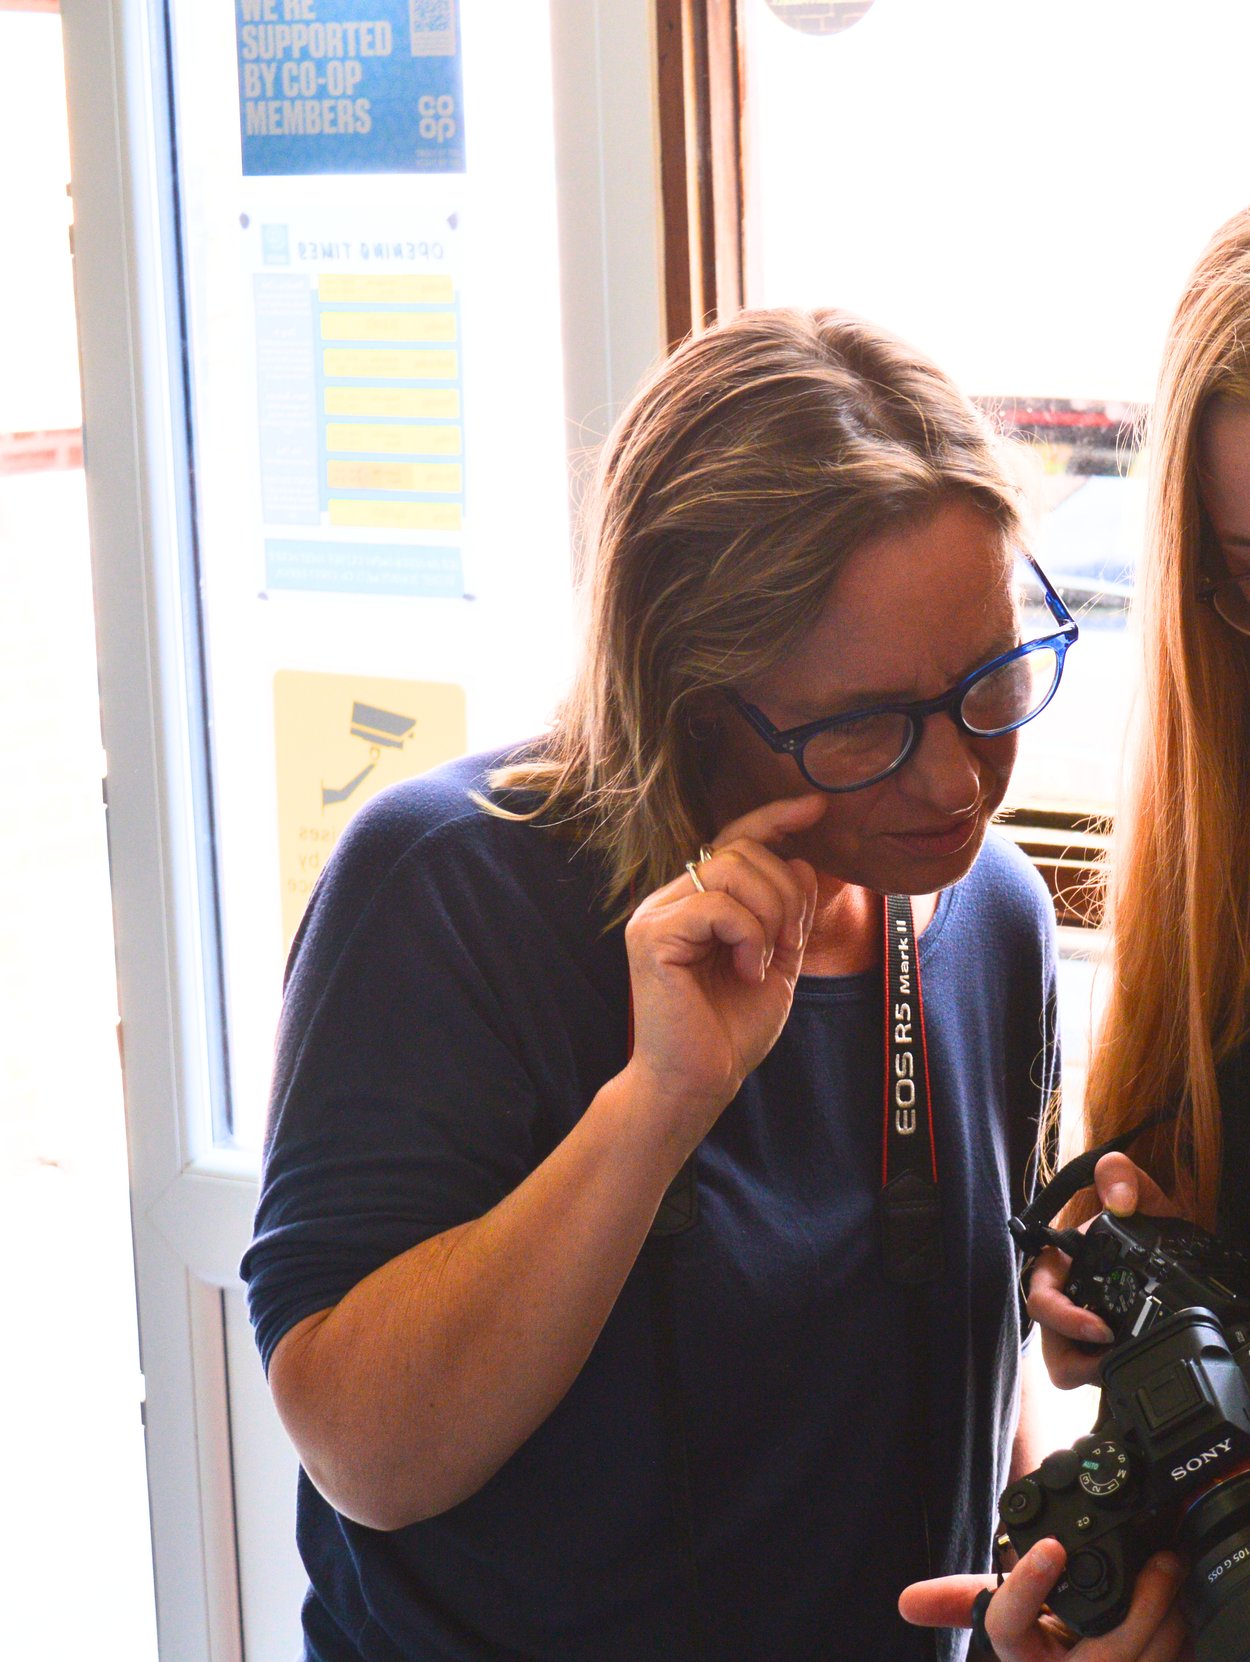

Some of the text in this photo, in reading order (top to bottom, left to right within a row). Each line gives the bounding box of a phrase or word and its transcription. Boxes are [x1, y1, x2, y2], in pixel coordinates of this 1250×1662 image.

[242, 21, 392, 59] SUPPORTED
[244, 61, 362, 98] BY CO-OP
[246, 99, 372, 136] MEMBERS
[897, 936, 911, 995] Mark
[895, 1002, 913, 1044] R5
[895, 1051, 917, 1136] EOS
[1107, 1445, 1116, 1453] A
[1082, 1460, 1099, 1470] AUTO
[1117, 1454, 1126, 1463] S
[1171, 1438, 1232, 1481] SONY
[1083, 1475, 1090, 1485] 3
[1117, 1469, 1127, 1479] M
[1092, 1485, 1101, 1493] 2
[1077, 1516, 1090, 1527] C2
[1224, 1559, 1232, 1569] G
[1207, 1565, 1224, 1583] OSS
